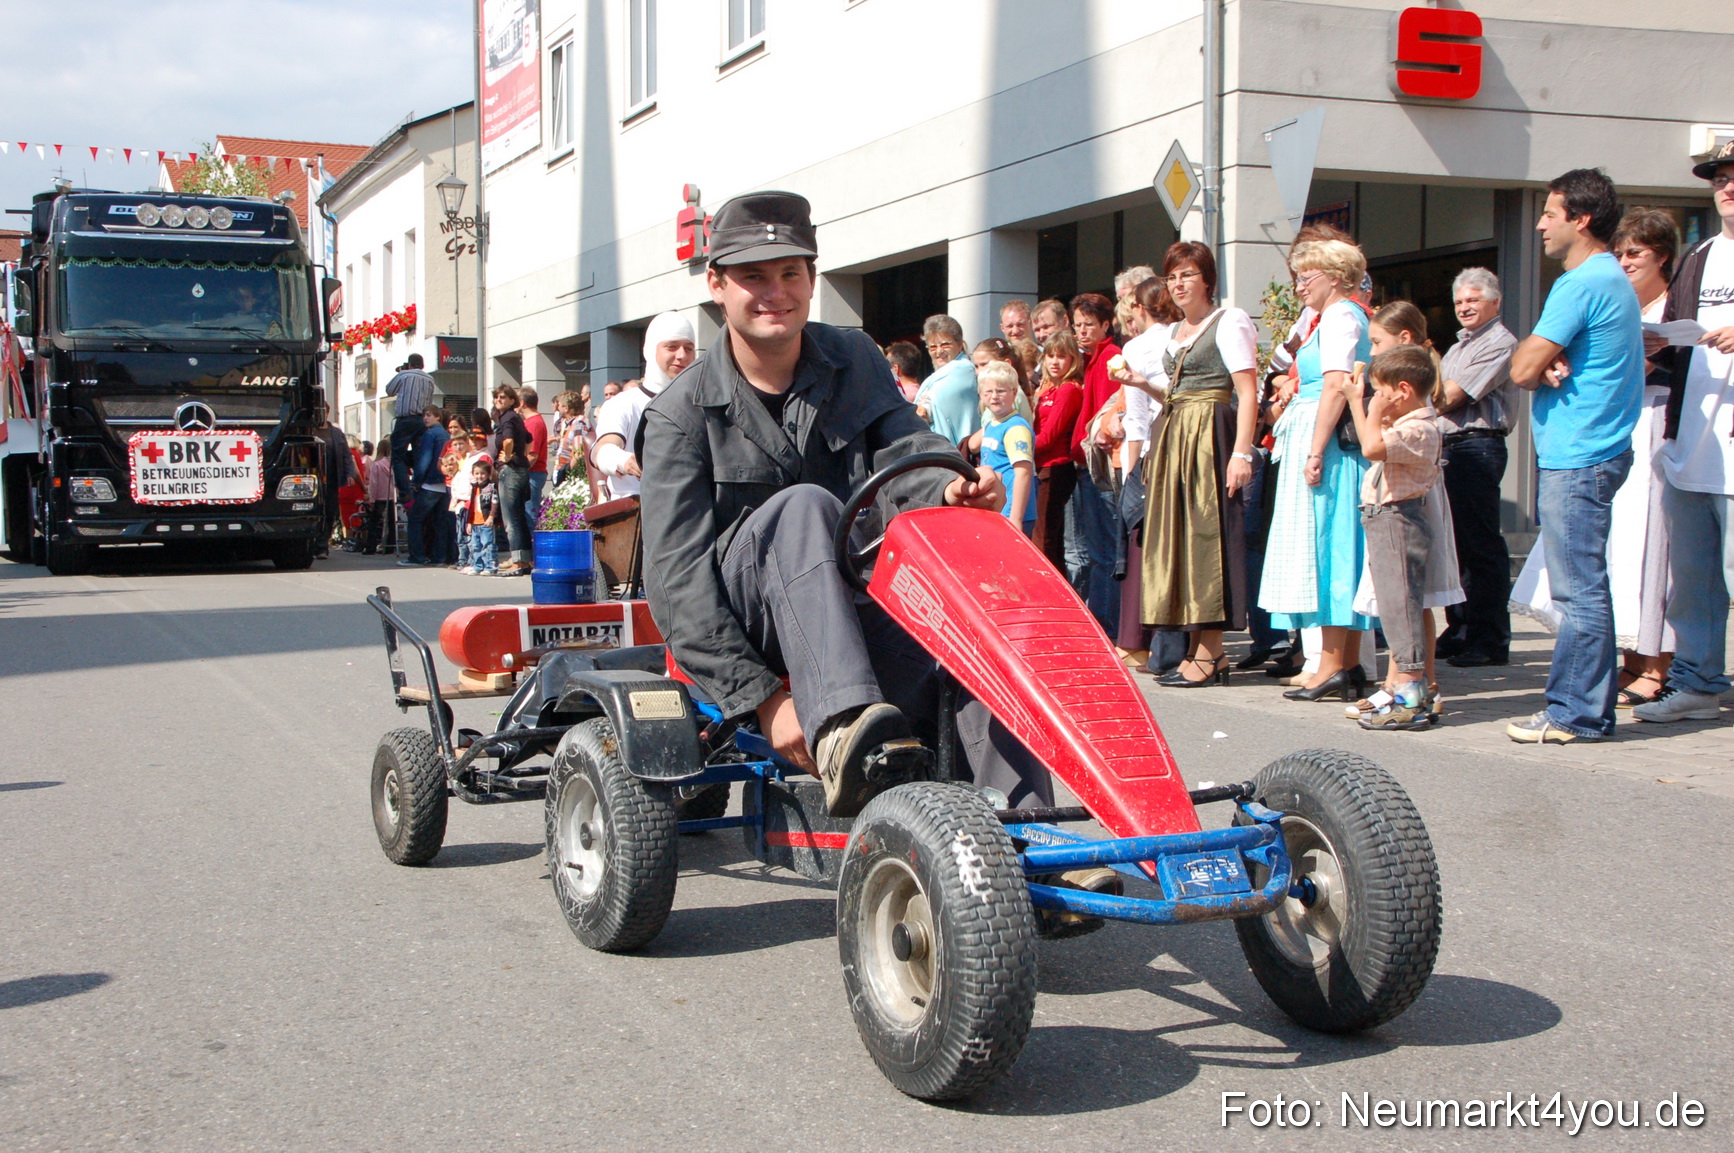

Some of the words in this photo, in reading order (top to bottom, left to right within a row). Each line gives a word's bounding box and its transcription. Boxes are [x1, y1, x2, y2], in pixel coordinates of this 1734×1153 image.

[440, 216, 477, 234] MOD
[443, 355, 464, 363] Mode
[465, 355, 474, 363] für
[241, 376, 299, 386] LANGE
[169, 441, 221, 464] BRK
[142, 466, 251, 480] BETREUUNGSDIENST
[143, 482, 208, 495] BEILNGRIES
[892, 568, 945, 630] BERG
[1021, 827, 1051, 846] SPEEDY
